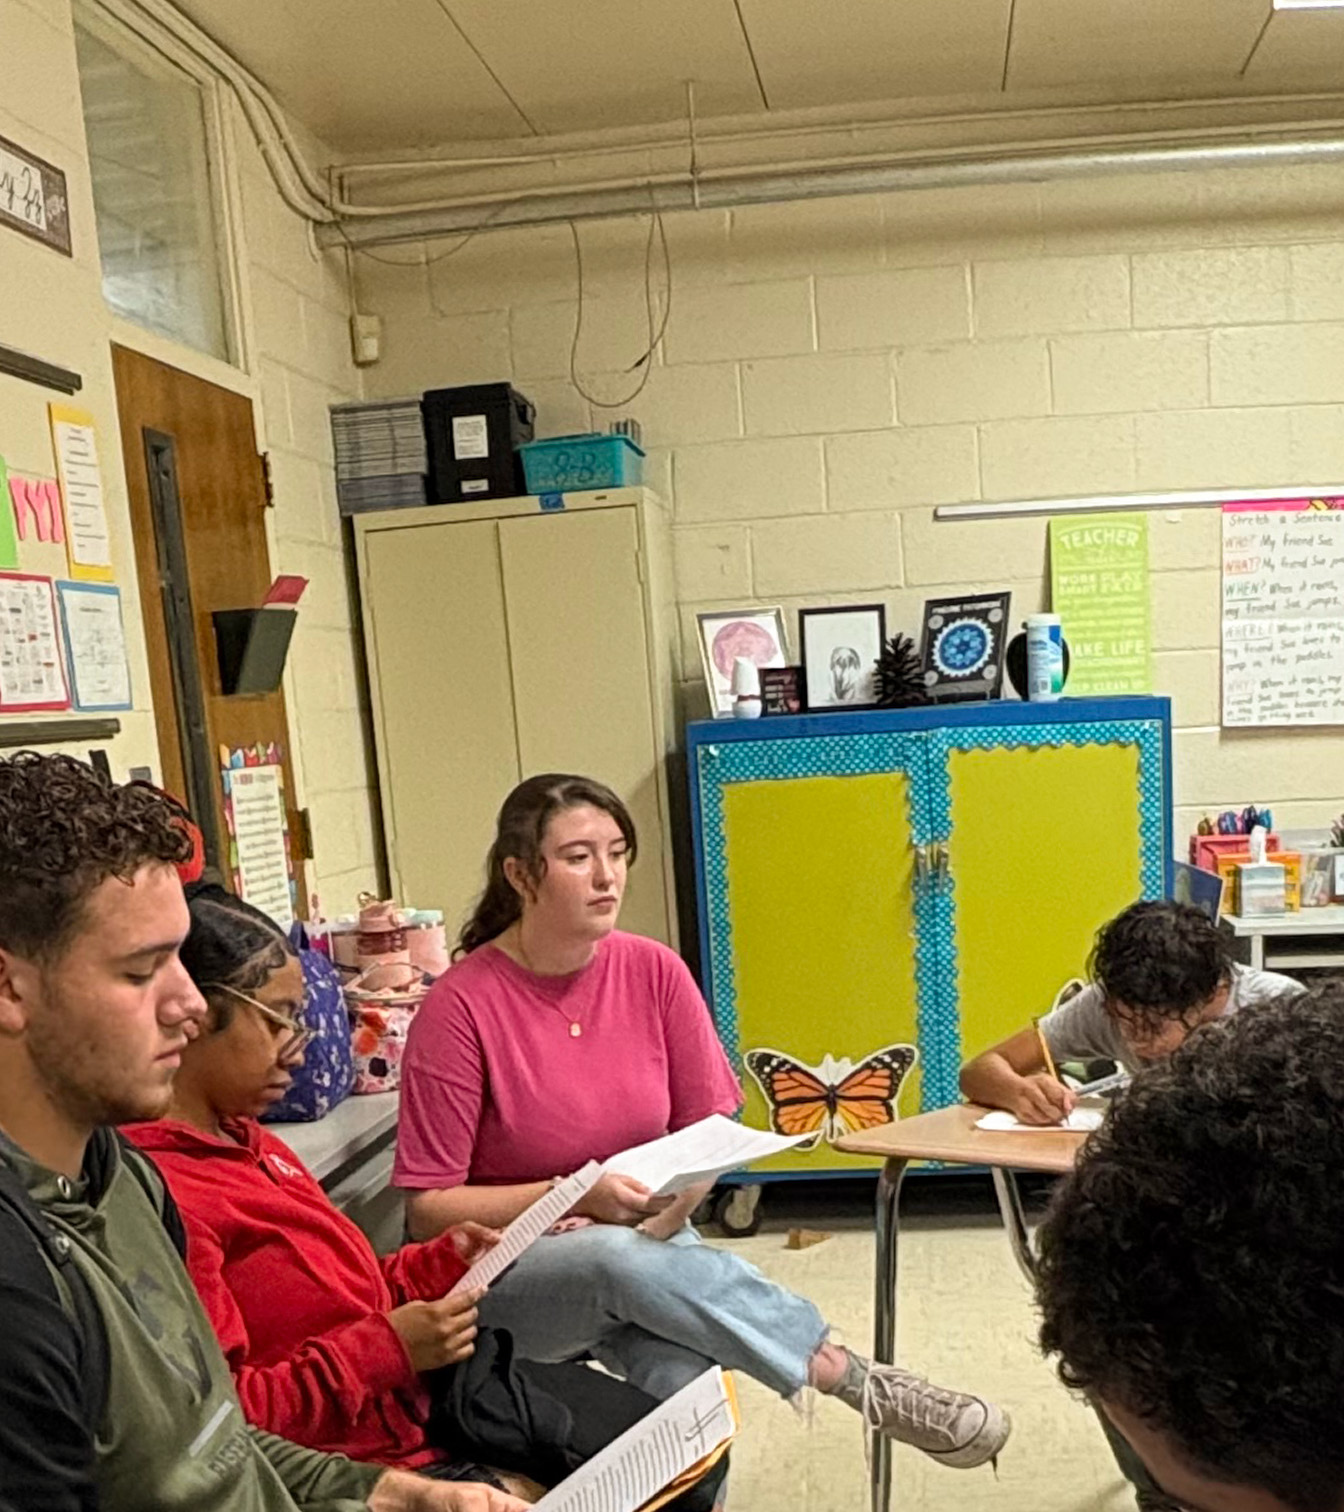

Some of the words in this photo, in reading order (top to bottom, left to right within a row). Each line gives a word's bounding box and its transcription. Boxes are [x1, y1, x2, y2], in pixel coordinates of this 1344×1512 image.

[1229, 512, 1270, 527] Stretch
[1059, 526, 1140, 551] TEACHER
[1073, 640, 1105, 658] AKE
[1111, 638, 1146, 657] LIFE
